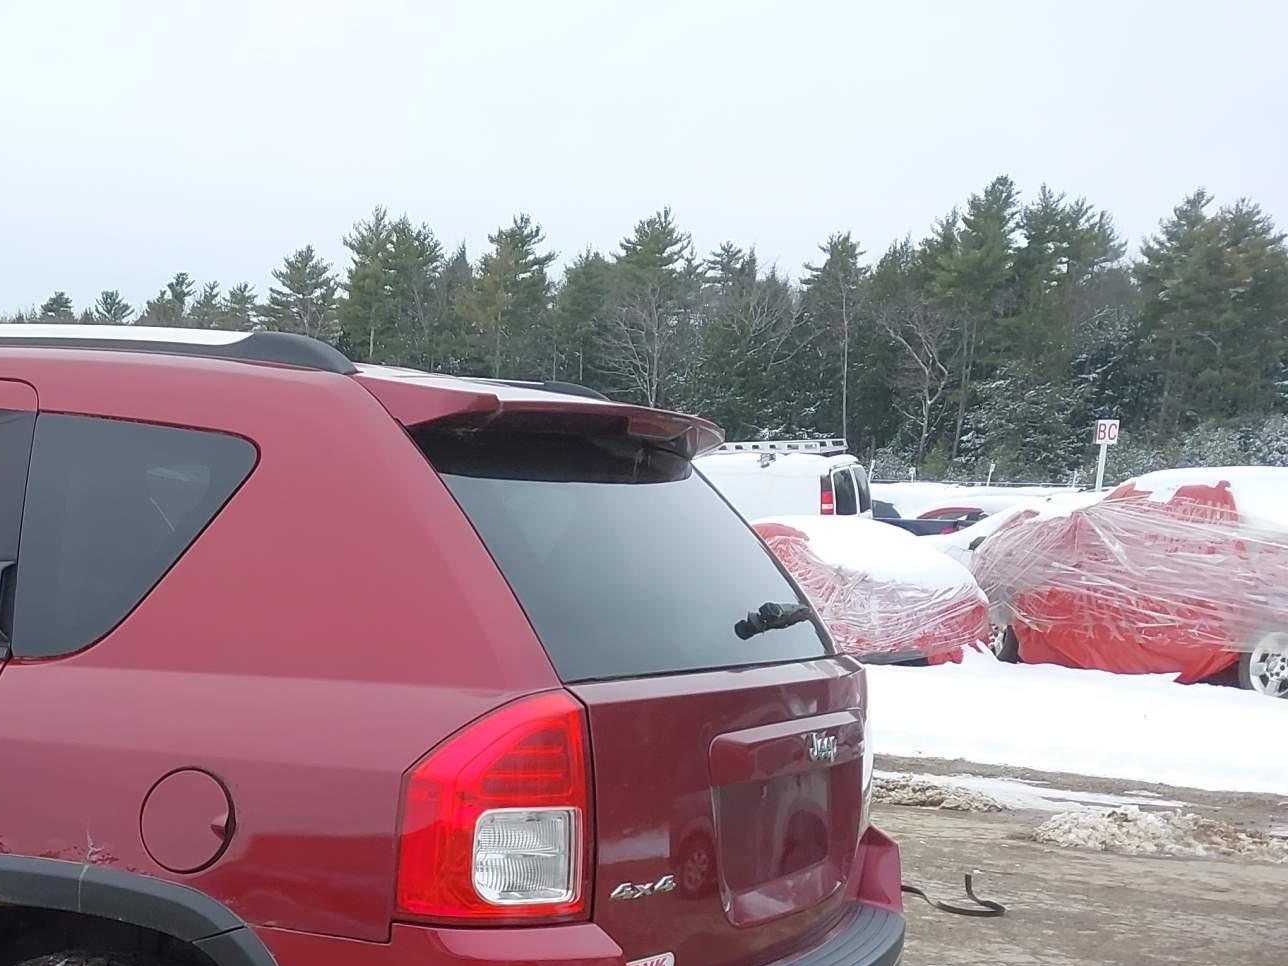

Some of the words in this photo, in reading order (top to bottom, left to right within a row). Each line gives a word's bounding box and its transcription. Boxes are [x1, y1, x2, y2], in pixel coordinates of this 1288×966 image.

[1097, 423, 1118, 441] BC
[808, 732, 838, 762] Jeep
[610, 874, 677, 900] 4x4
